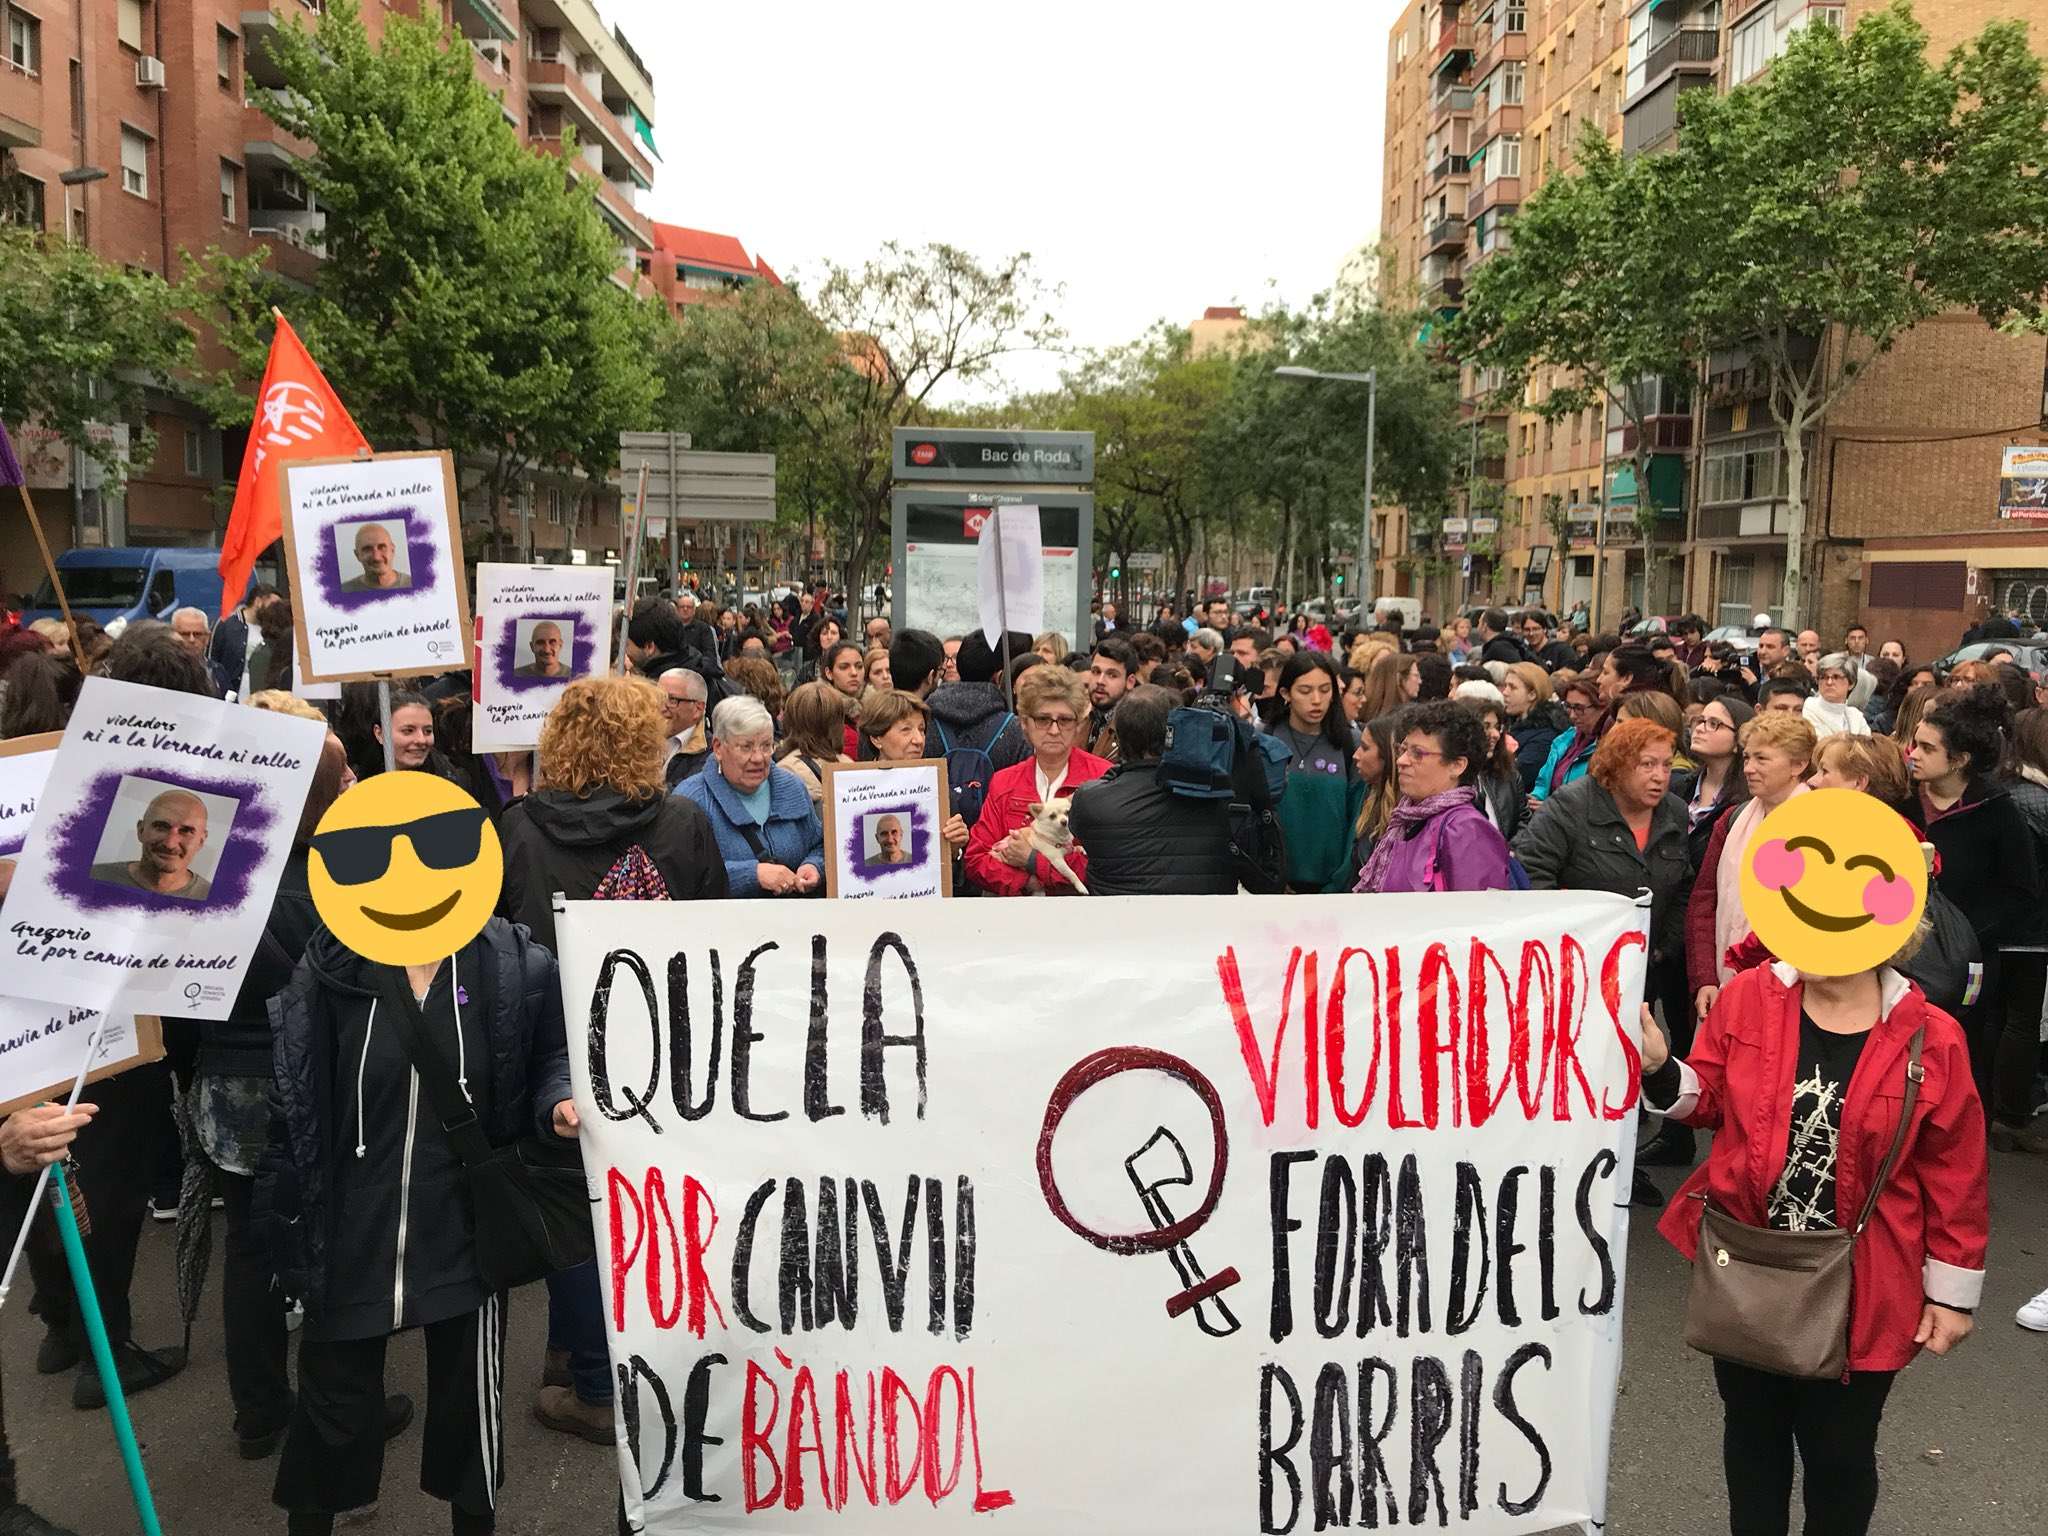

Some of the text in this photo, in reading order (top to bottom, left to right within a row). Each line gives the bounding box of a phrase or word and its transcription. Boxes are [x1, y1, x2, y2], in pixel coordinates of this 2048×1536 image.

[981, 448, 1071, 464] Bac de Roda
[302, 499, 313, 509] ni
[326, 495, 338, 507] la
[340, 487, 383, 504] Verneda
[386, 487, 396, 498] ni
[400, 482, 433, 496] enlloc
[310, 483, 350, 496] violadors
[315, 623, 359, 640] Gregorio
[323, 618, 452, 650] la por canvia de bàndol
[105, 714, 178, 732] violadors
[82, 729, 302, 770] ni a la Verneda ni enlloc
[10, 920, 92, 946] Gregorio
[16, 939, 238, 971] la por canvia de bàndol
[44, 1016, 63, 1036] de
[586, 930, 928, 1135] QUE LA
[1216, 930, 1648, 1131] VIOLADORS
[606, 1165, 729, 1341] POR
[1269, 1147, 1619, 1344] FORA DELS
[616, 1345, 1016, 1515] DE BÀNDOL
[1257, 1340, 1553, 1536] BARRIS
